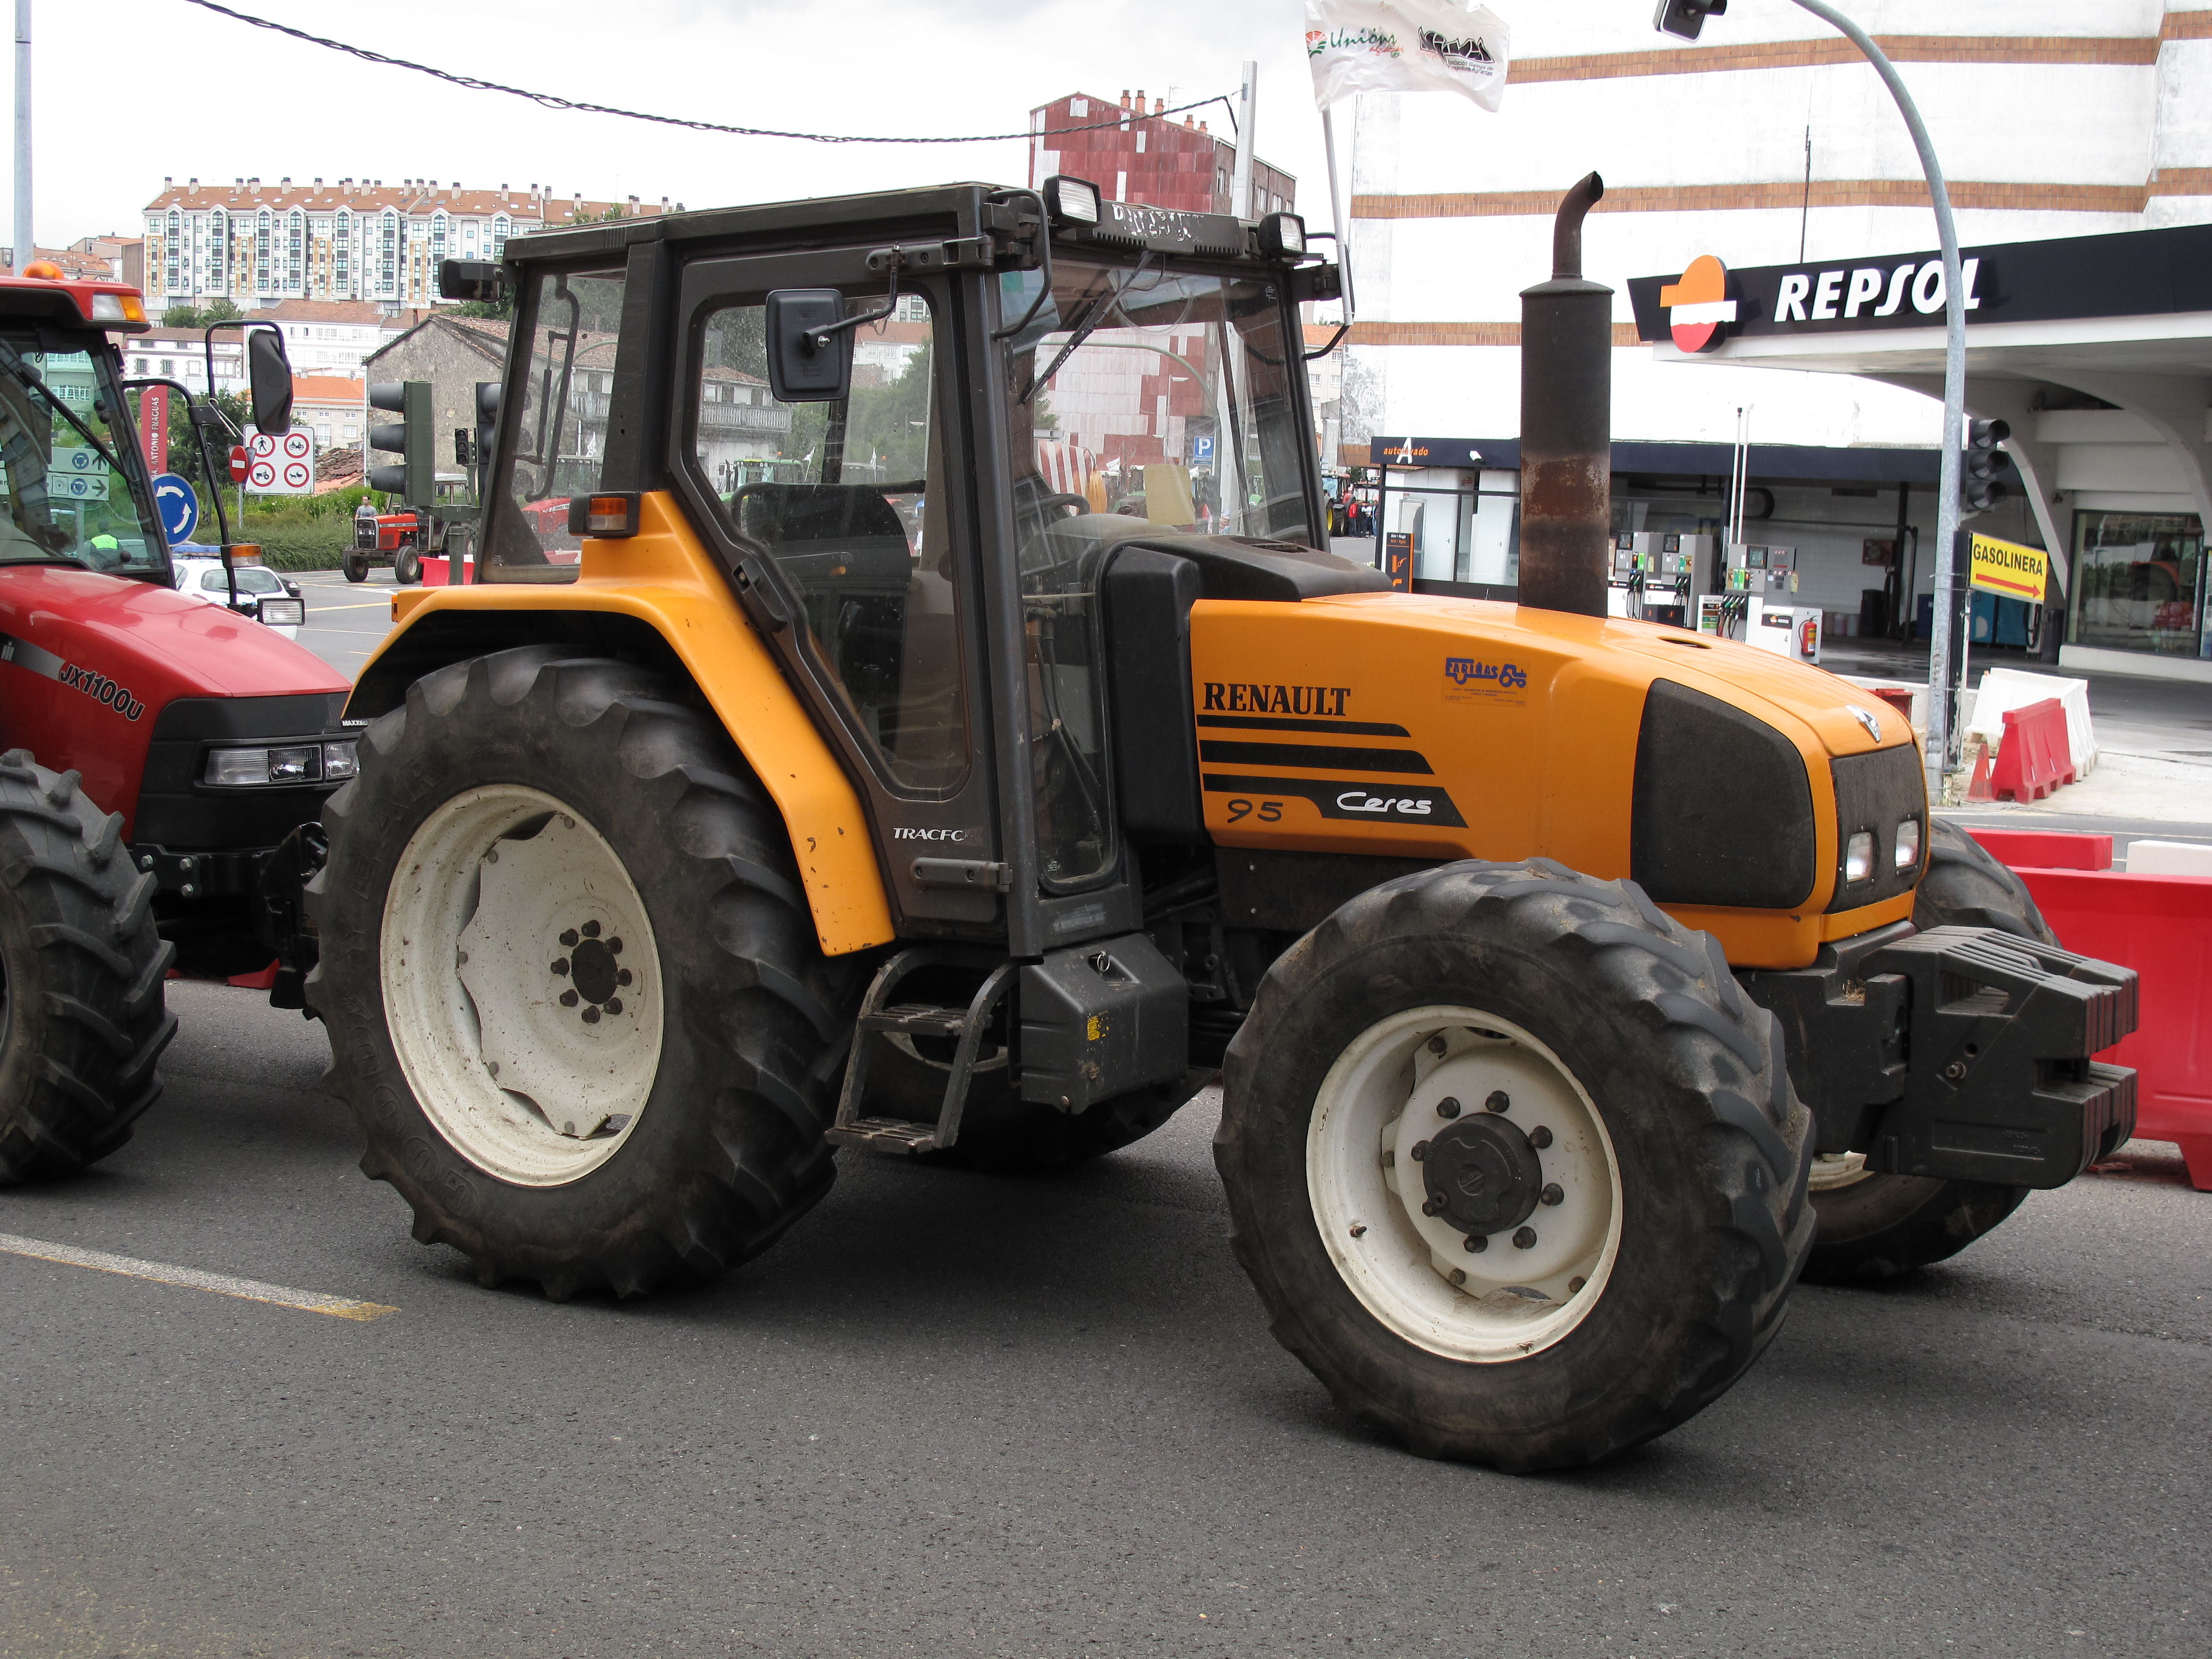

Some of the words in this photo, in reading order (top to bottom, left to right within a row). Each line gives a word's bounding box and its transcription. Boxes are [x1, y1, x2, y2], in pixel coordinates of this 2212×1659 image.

[1331, 27, 1397, 48] Unións
[1774, 258, 1980, 322] REPSOL
[151, 397, 160, 430] FRAGUAS
[1199, 438, 1211, 455] P
[1973, 543, 2042, 576] GASOLINERA
[1784, 635, 1788, 644] 4
[1446, 657, 1498, 679] FARIÑAS
[60, 664, 146, 721] JX1100U
[1203, 682, 1350, 716] RENAULT
[1227, 799, 1283, 823] 95
[1336, 791, 1432, 814] Ceres
